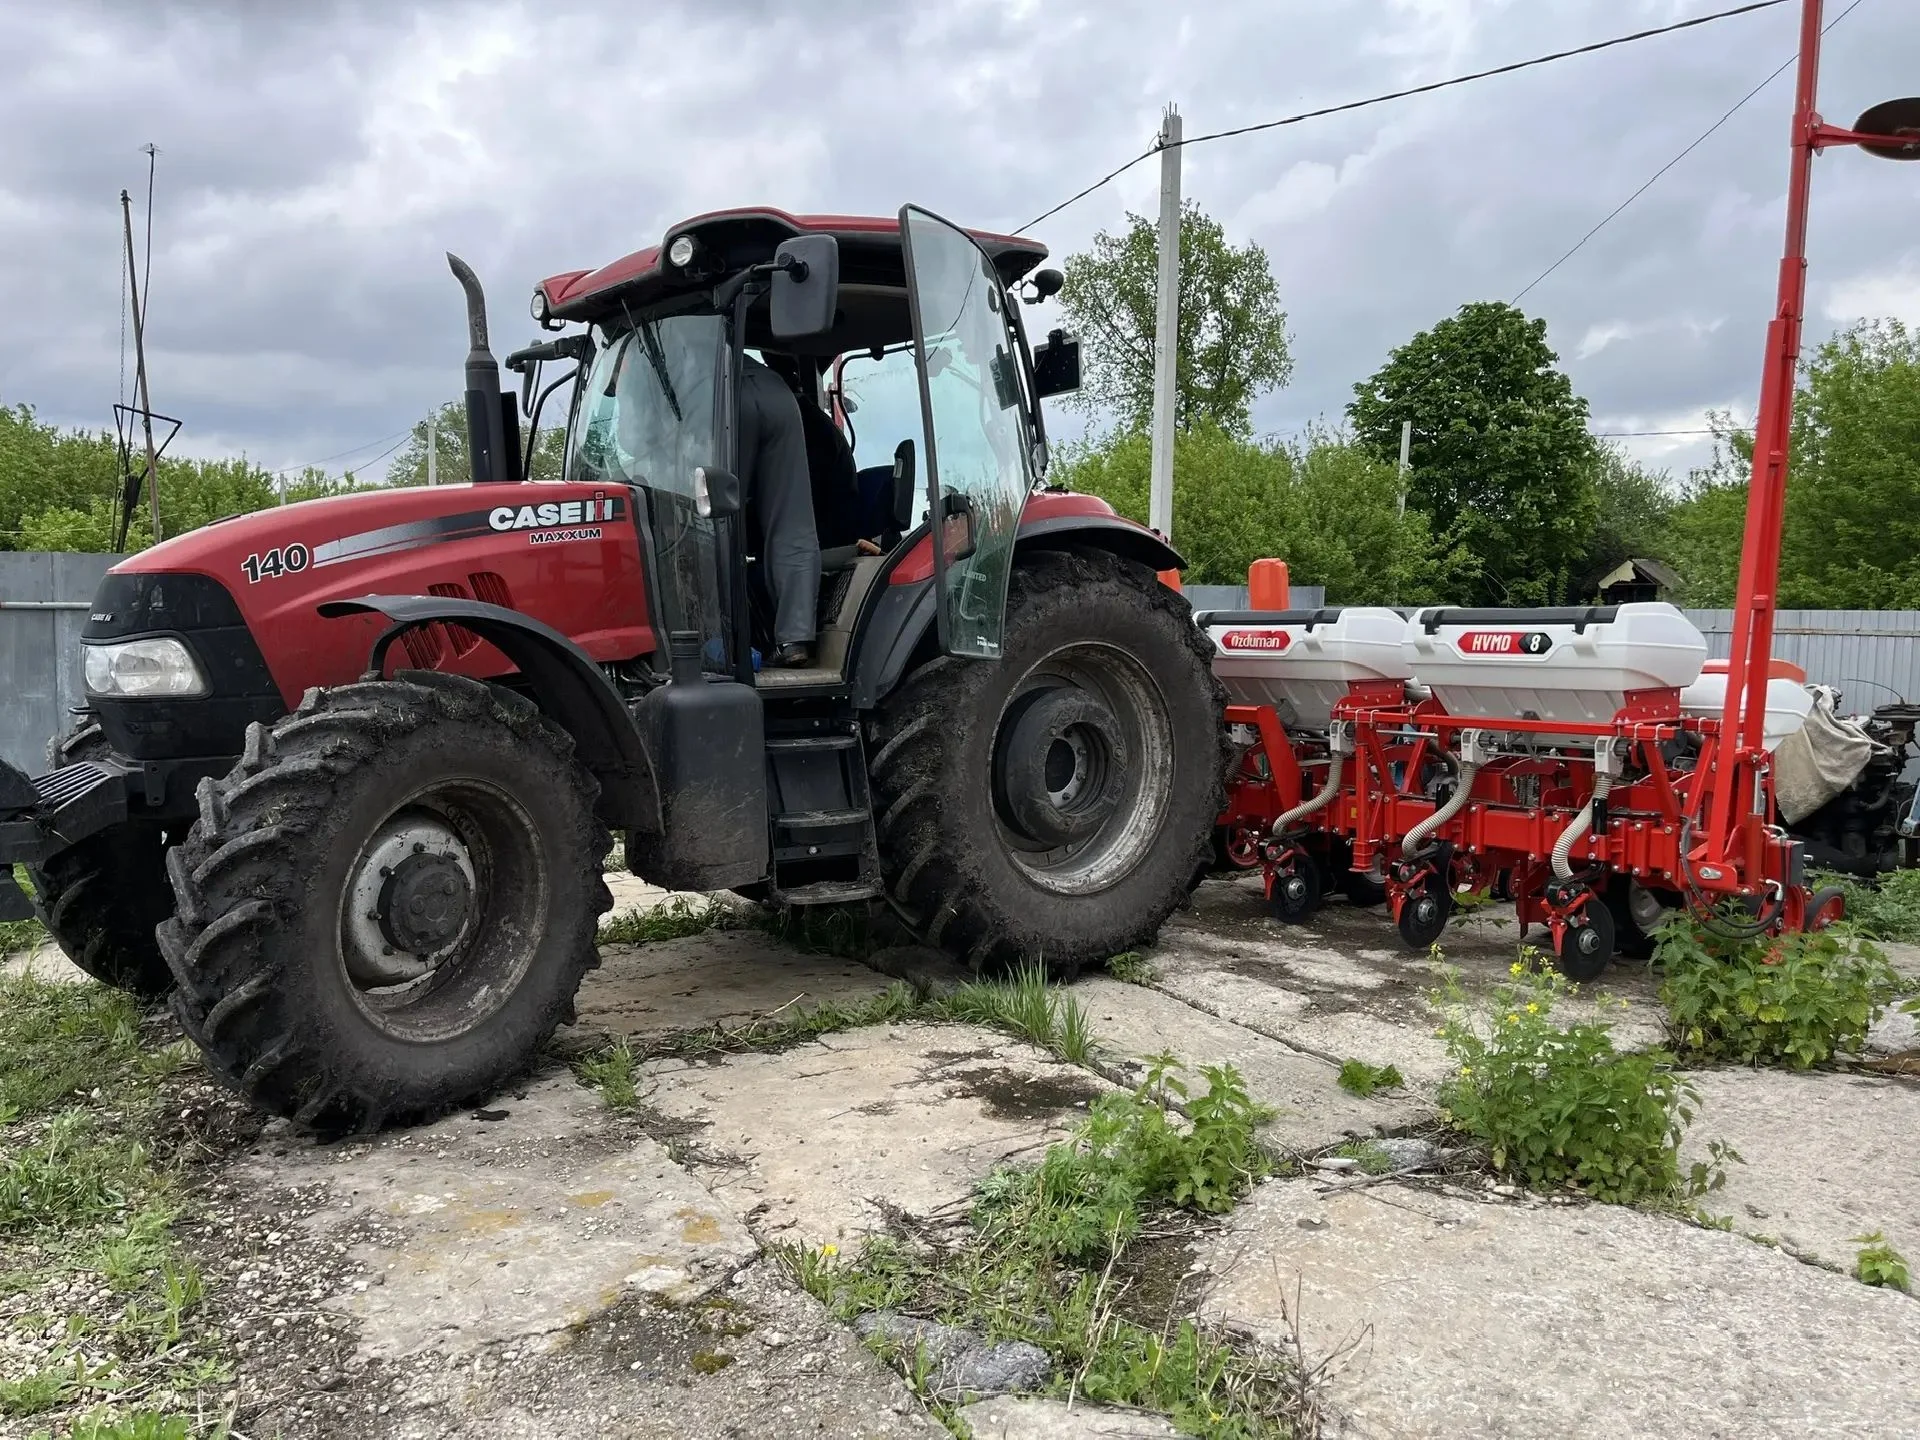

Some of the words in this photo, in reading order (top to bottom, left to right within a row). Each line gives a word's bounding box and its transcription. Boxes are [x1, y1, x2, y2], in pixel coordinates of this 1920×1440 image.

[529, 528, 602, 544] MAXXUM
[241, 542, 309, 584] 140
[1472, 634, 1512, 652] HVMD
[1529, 634, 1542, 652] 8
